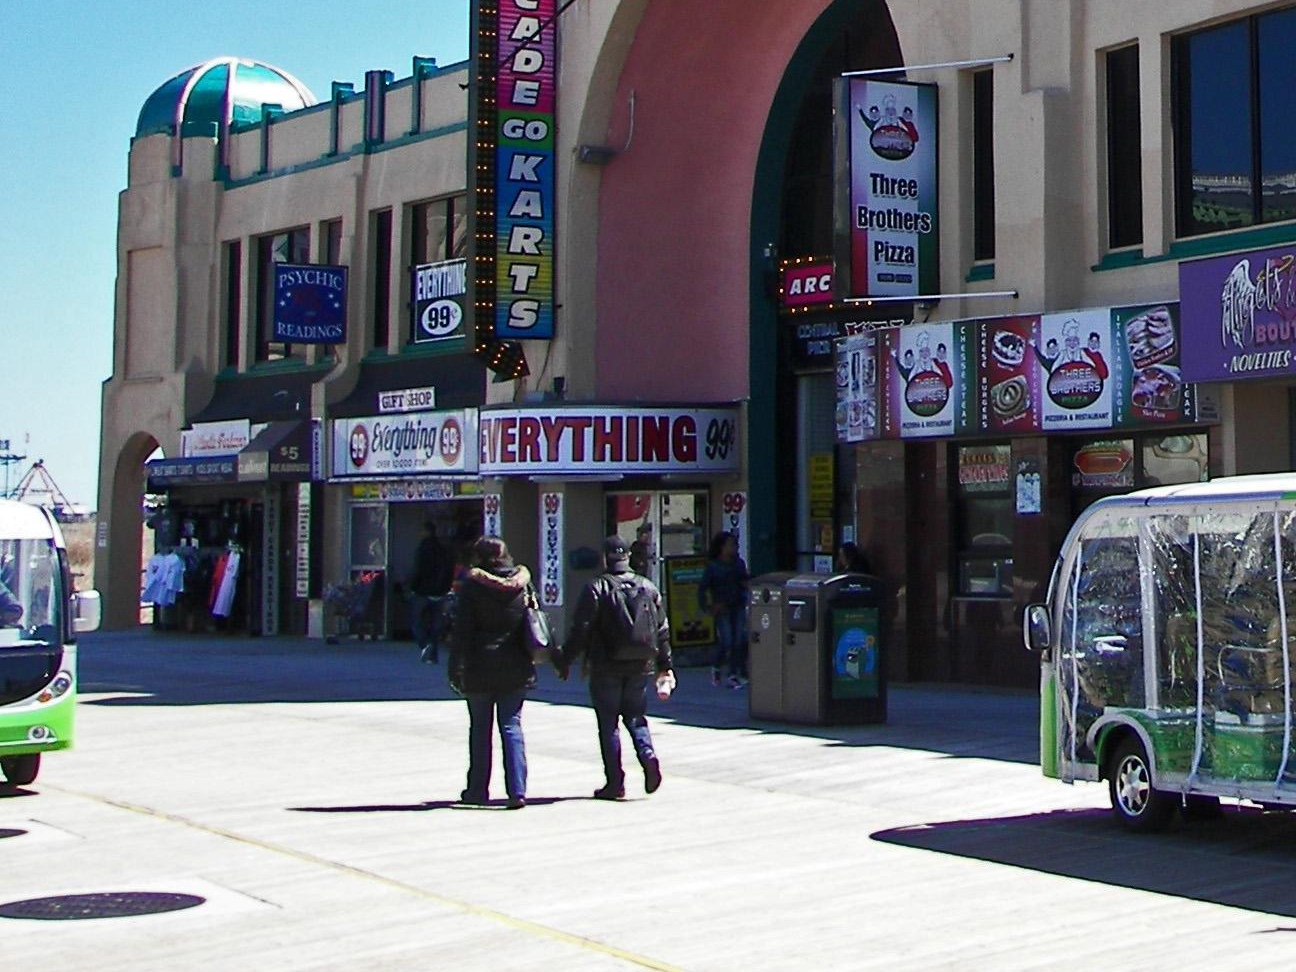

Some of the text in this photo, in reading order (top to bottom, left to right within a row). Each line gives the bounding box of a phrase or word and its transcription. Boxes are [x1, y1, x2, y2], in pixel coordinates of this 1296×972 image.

[503, 118, 549, 141] GO
[869, 172, 918, 198] Three
[857, 206, 931, 234] Brothers
[507, 154, 545, 329] KARTS
[873, 241, 916, 265] Pizza
[279, 270, 342, 290] PSYCHIC
[789, 274, 832, 295] ARC
[278, 321, 343, 338] READINGS
[1229, 350, 1291, 372] NOVELTIES
[381, 391, 432, 409] GIFT SHOP
[371, 419, 438, 459] Everything
[480, 414, 698, 464] EVERYTHING
[280, 445, 299, 460] $5
